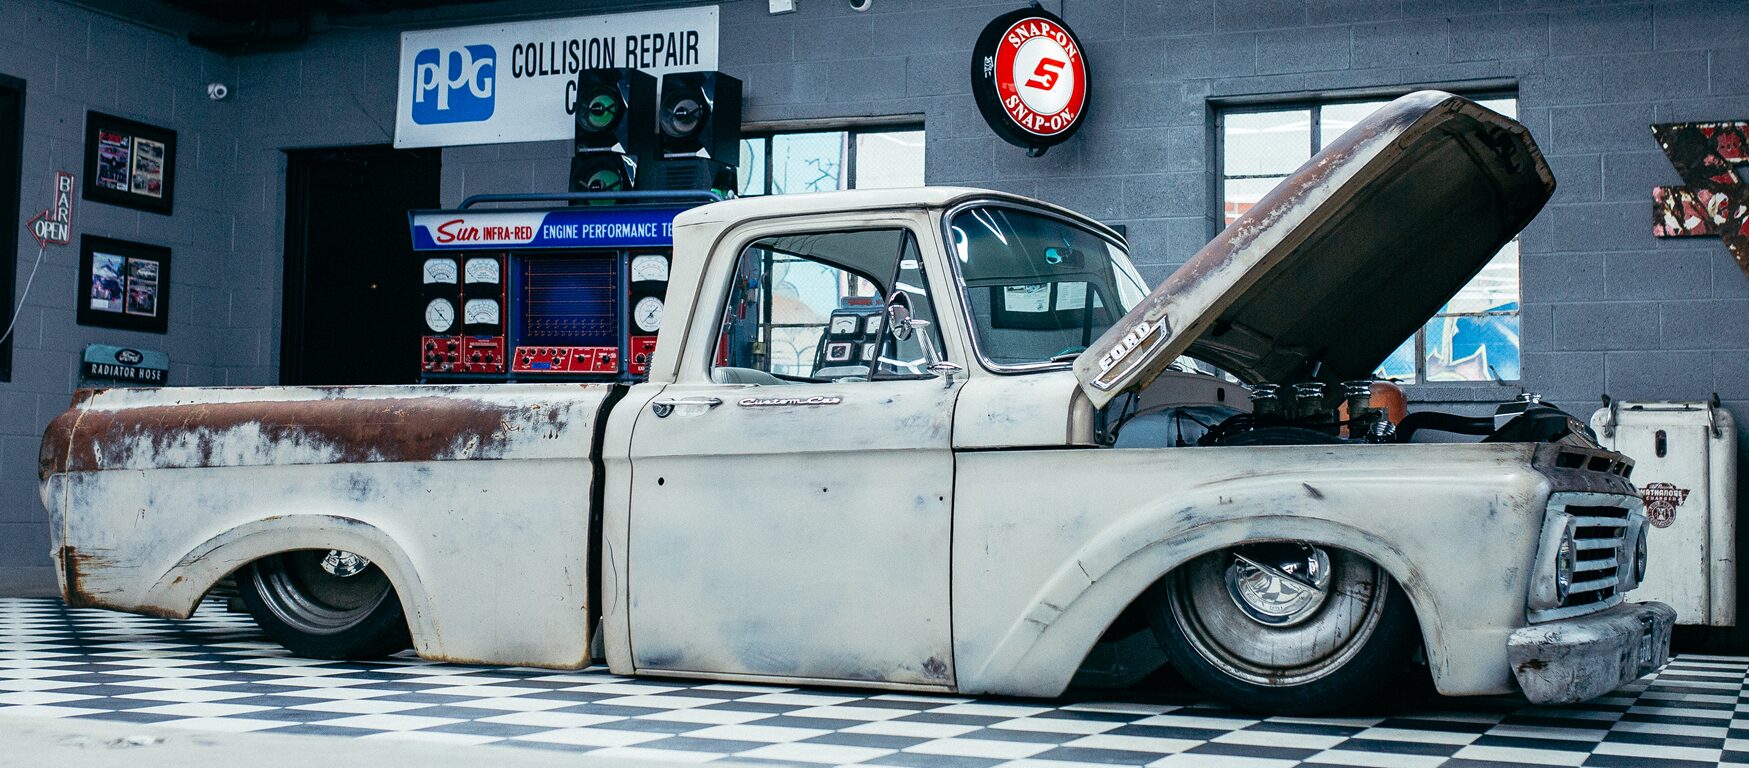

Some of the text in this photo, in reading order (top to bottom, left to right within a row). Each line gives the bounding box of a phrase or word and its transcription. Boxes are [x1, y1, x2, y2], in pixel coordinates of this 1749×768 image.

[511, 30, 700, 78] COLLISION REPAIR
[58, 175, 70, 222] BAR
[35, 220, 68, 241] OPEN
[437, 219, 480, 244] Sun
[483, 225, 533, 241] INFRA-RED
[543, 224, 578, 240] ENGINE
[582, 222, 657, 239] PERFORMANCE
[119, 350, 140, 363] Ford
[1099, 321, 1151, 371] FORD
[91, 363, 161, 380] RADIATOR HOSE
